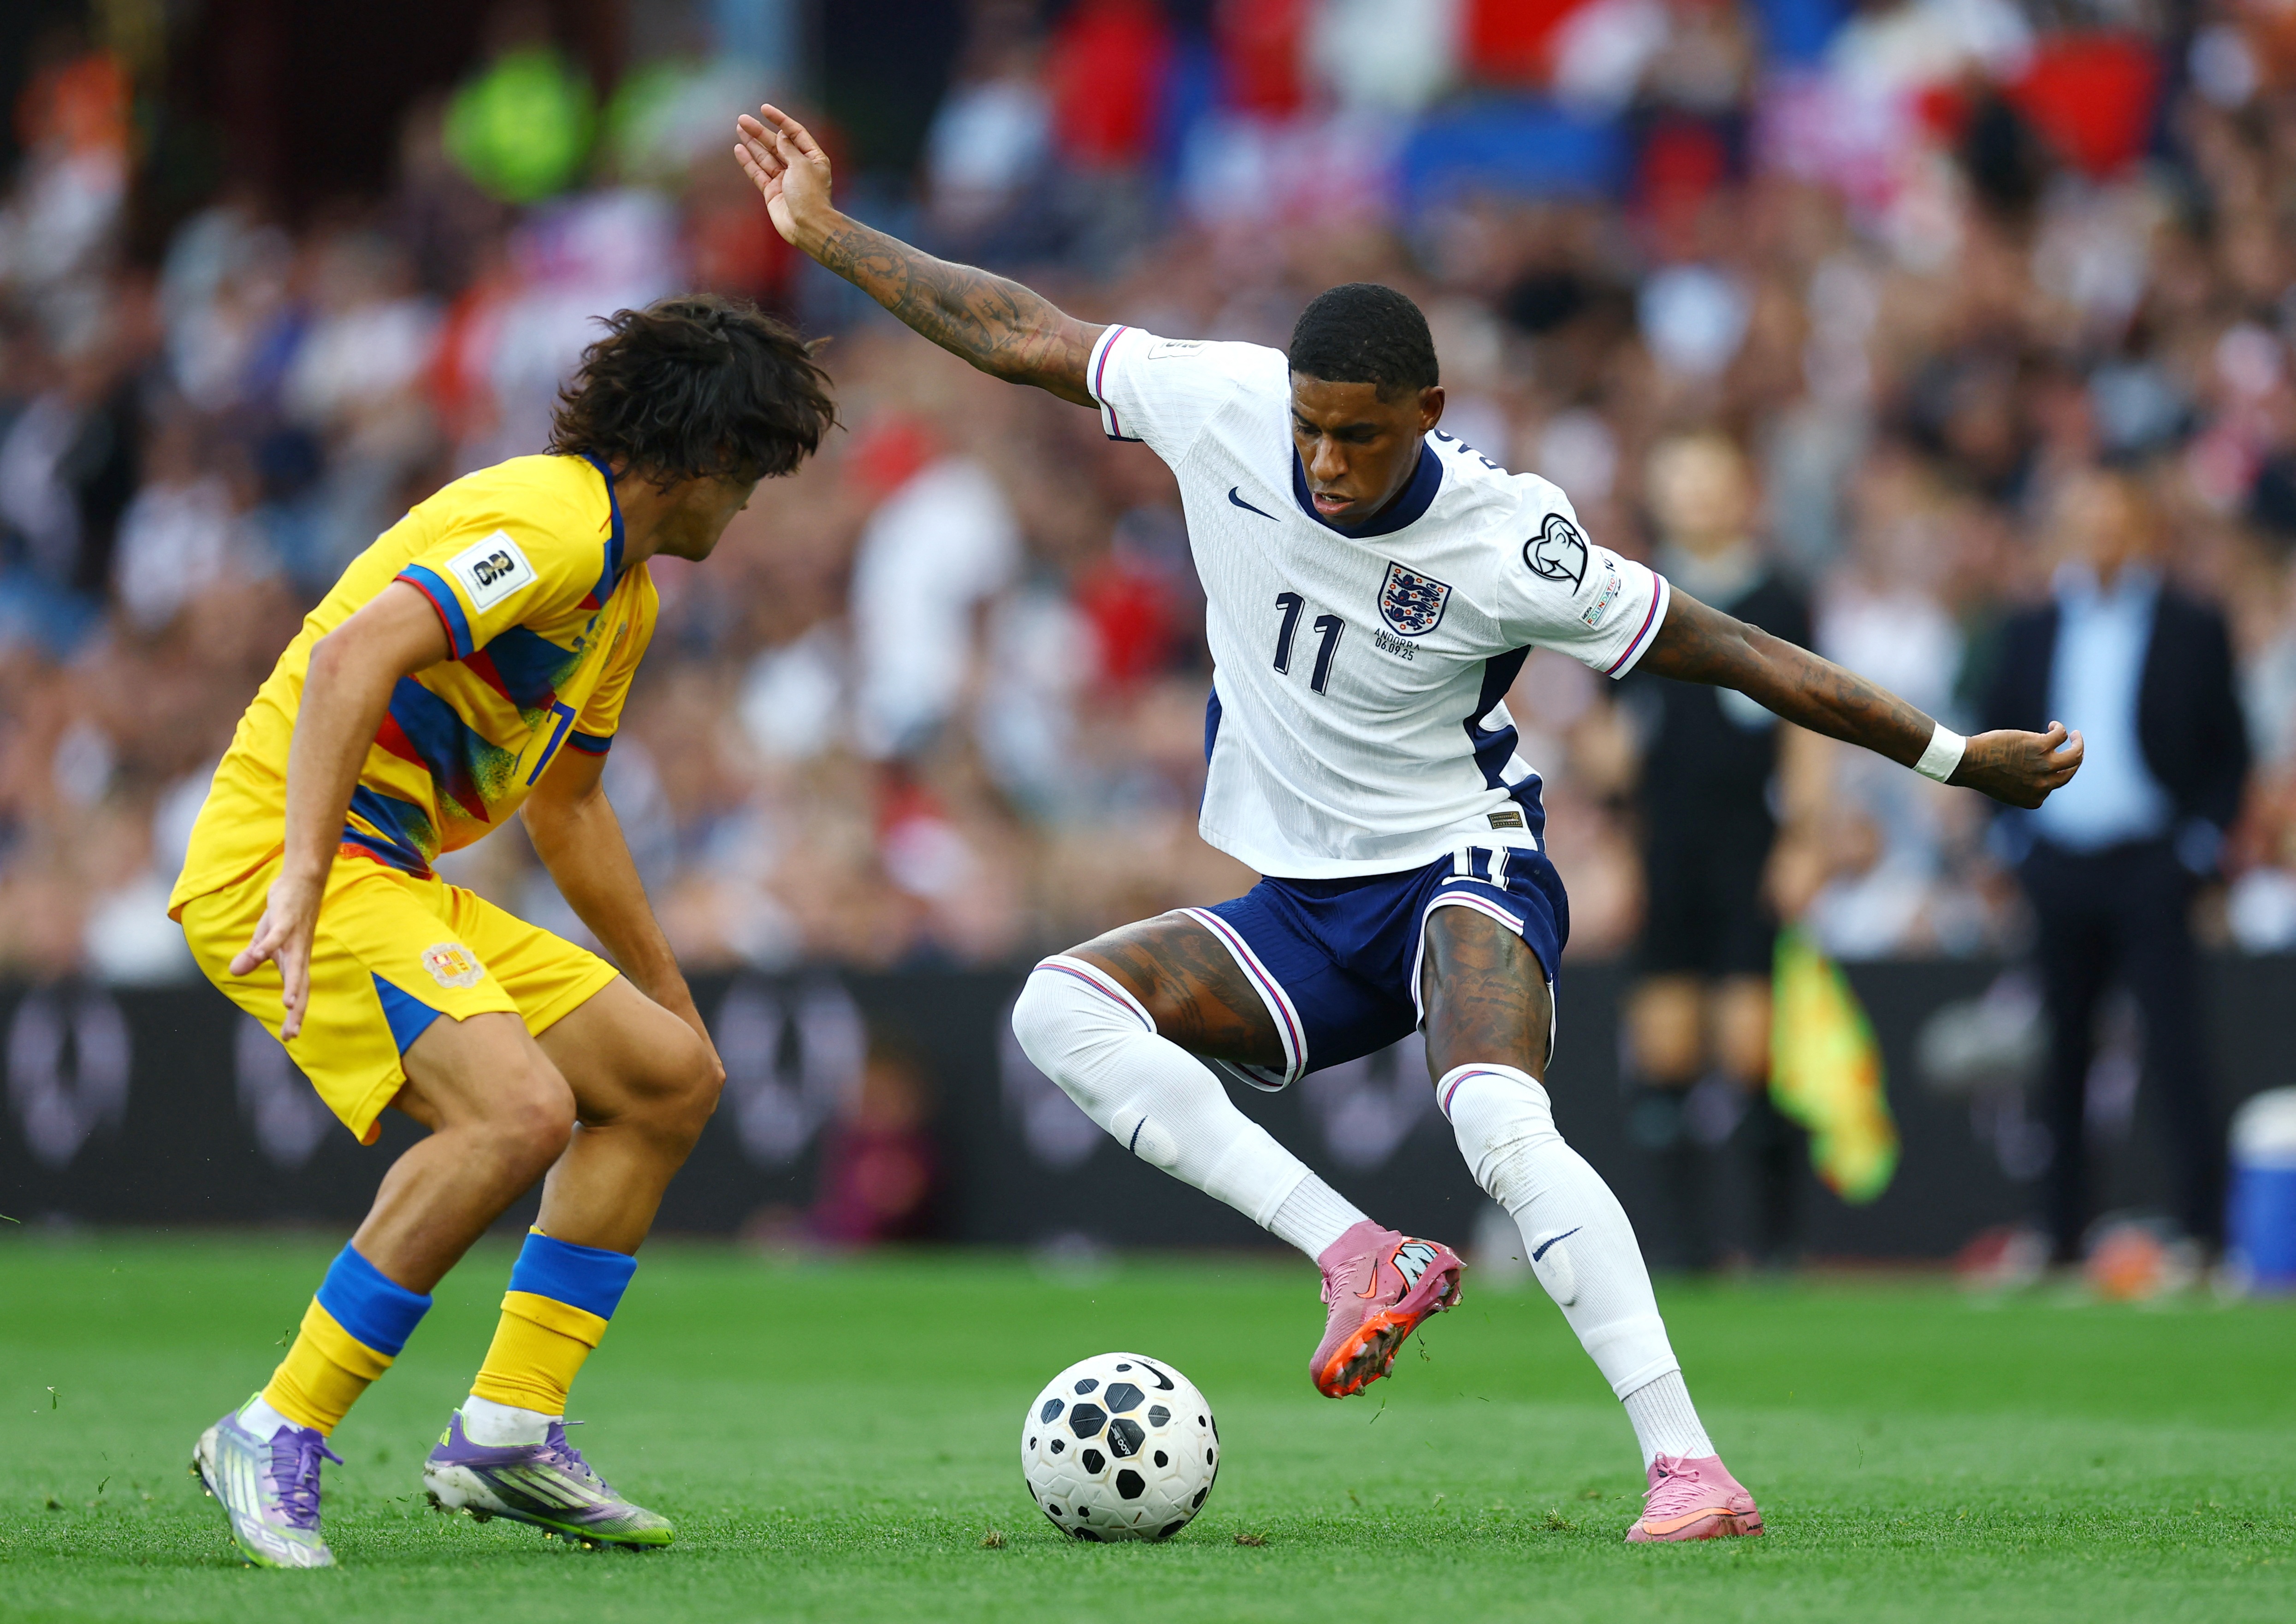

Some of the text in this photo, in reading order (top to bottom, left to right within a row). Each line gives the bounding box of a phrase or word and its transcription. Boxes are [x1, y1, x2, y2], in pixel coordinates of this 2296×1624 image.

[1582, 607, 1593, 620] UEFA
[1587, 573, 1615, 624] FOUNDATION
[1273, 592, 1345, 696] 11
[1374, 628, 1420, 651] ANDORRA
[1375, 637, 1414, 661] 06.09.25
[239, 1517, 312, 1568] F50
